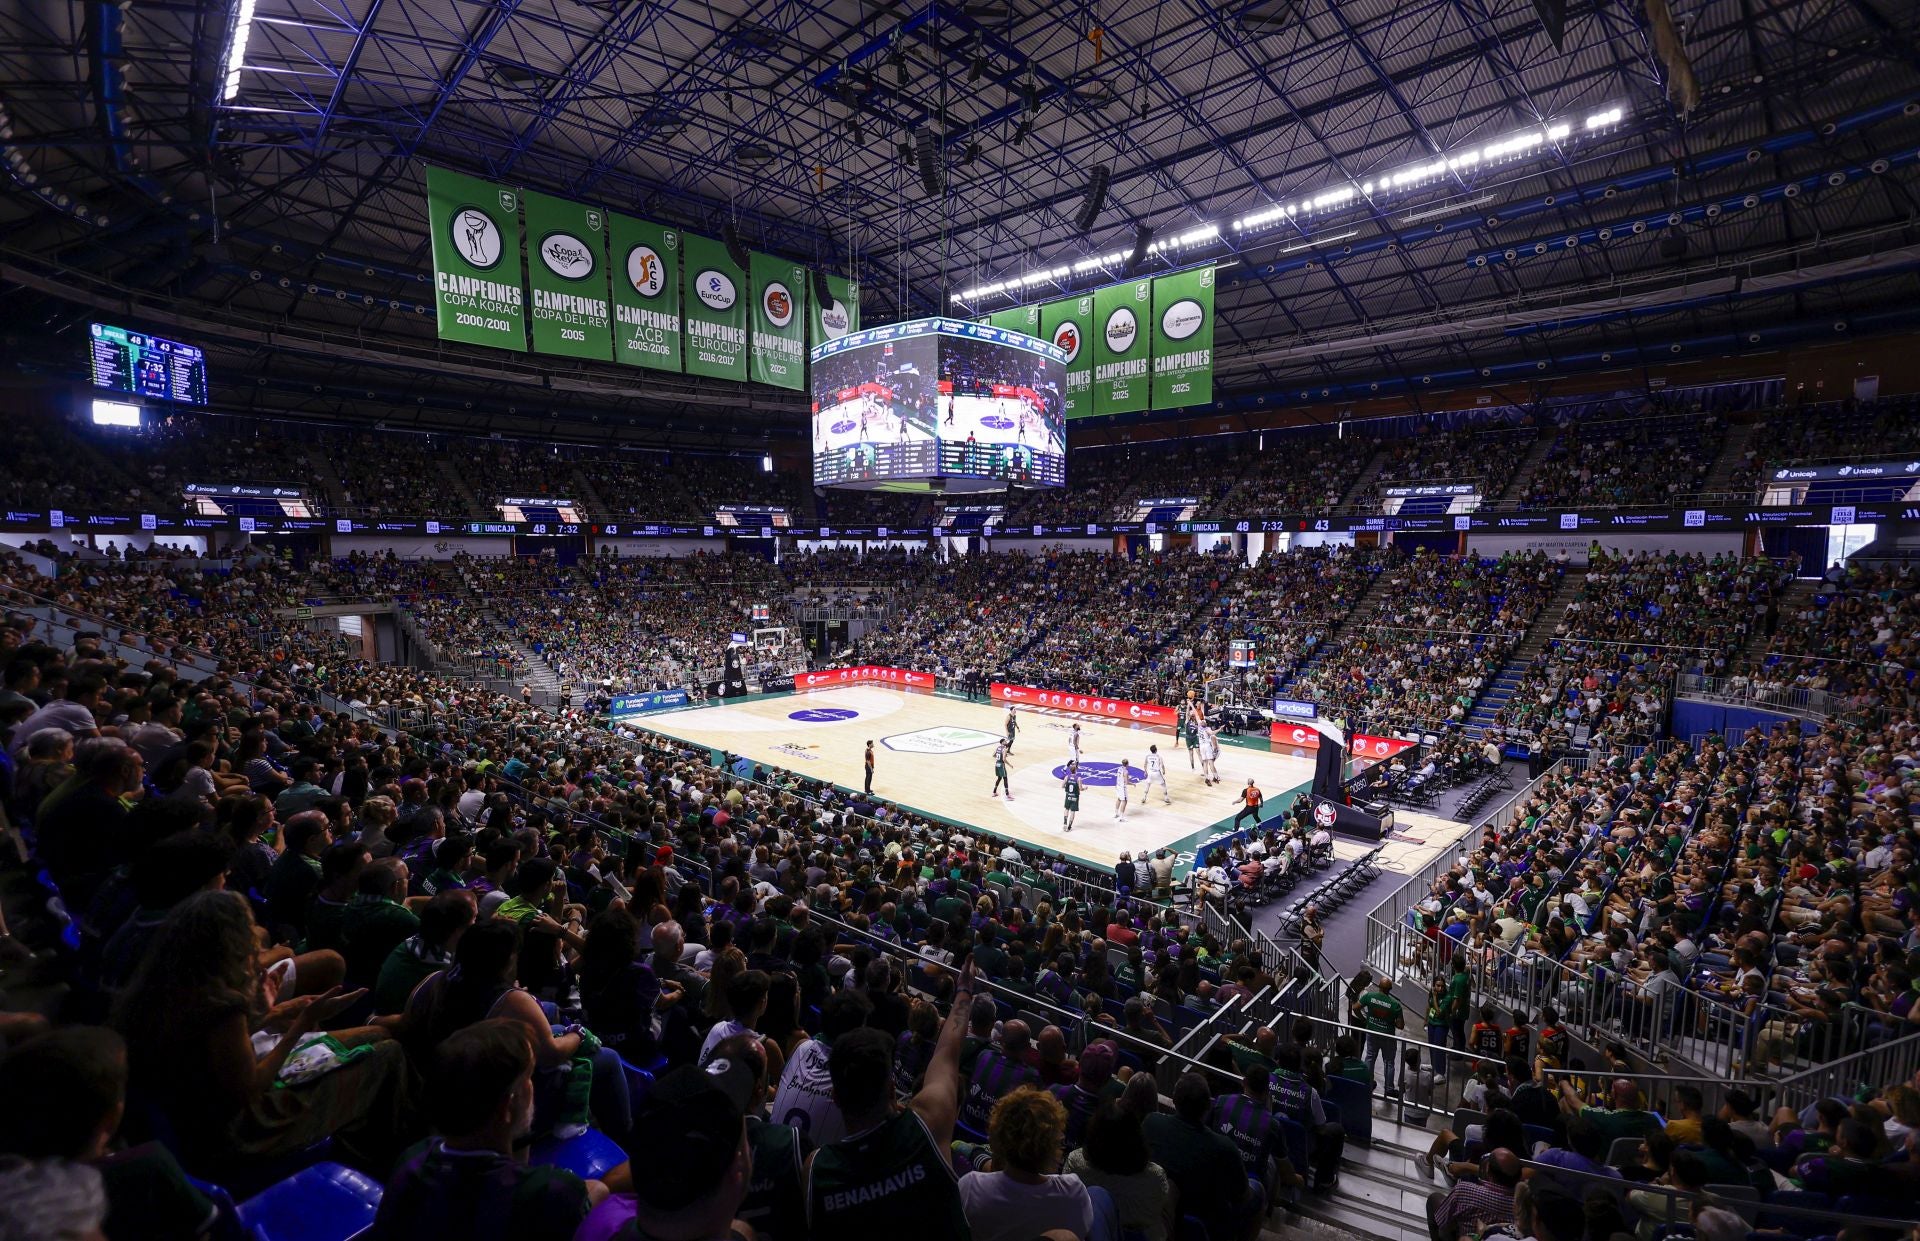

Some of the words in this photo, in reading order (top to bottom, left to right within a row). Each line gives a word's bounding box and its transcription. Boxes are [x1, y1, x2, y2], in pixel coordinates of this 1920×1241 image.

[548, 248, 573, 263] Rey
[554, 244, 577, 257] Copa
[438, 272, 521, 305] CAMPEONES
[534, 289, 607, 318] CAMPEONES
[701, 290, 731, 304] EuroCup
[444, 293, 476, 310] COPA
[479, 298, 519, 317] KORAC
[456, 313, 511, 332] 2000/2001
[533, 308, 563, 322] COPA
[565, 313, 585, 326] DEL
[589, 316, 609, 329] REY
[616, 304, 679, 332] CAMPEONES
[561, 329, 585, 341] 2005
[635, 326, 664, 343] ACB
[687, 319, 745, 344] CAMPEONES
[130, 336, 141, 344] 48
[160, 343, 170, 351] 43
[628, 339, 670, 355] 2005/2006
[692, 336, 741, 354] EUROCUP
[753, 331, 803, 354] CAMPEONES
[698, 351, 735, 366] 2016/2017
[751, 346, 773, 359] COPA
[773, 351, 788, 362] DEL
[789, 354, 803, 364] REY
[1155, 349, 1210, 373] CAMPEONES
[144, 361, 164, 373] 7:32
[770, 363, 787, 374] 2023
[1095, 358, 1147, 380] CAMPEONES
[1167, 366, 1210, 376] INTERCONTINENTAL
[1067, 369, 1091, 385] EONES
[1113, 380, 1128, 389] BCL
[1077, 384, 1091, 392] REY
[1112, 390, 1129, 400] 2025
[1171, 382, 1191, 394] 2025
[1066, 400, 1075, 409] 25
[1789, 470, 1817, 478] Unicaja
[1852, 467, 1883, 475] Unicaja
[485, 525, 516, 533] UNICAJA
[533, 524, 546, 534] 48
[558, 525, 578, 534] 7:32
[605, 525, 618, 535] 43
[1192, 523, 1220, 532] UNICAJA
[1236, 521, 1249, 532] 48
[1261, 521, 1283, 531] 7:32
[1300, 521, 1307, 530] 9
[1314, 520, 1329, 531] 43
[1234, 650, 1242, 661] 9
[1249, 650, 1255, 661] 9
[767, 678, 794, 688] endesa
[1229, 708, 1251, 716] endesa
[1276, 703, 1313, 715] endesa
[1482, 1037, 1497, 1047] 66
[1268, 1081, 1306, 1100] Balcerowski
[1233, 1129, 1262, 1147] Unicaja
[823, 1163, 927, 1213] BENAHAVÍS
